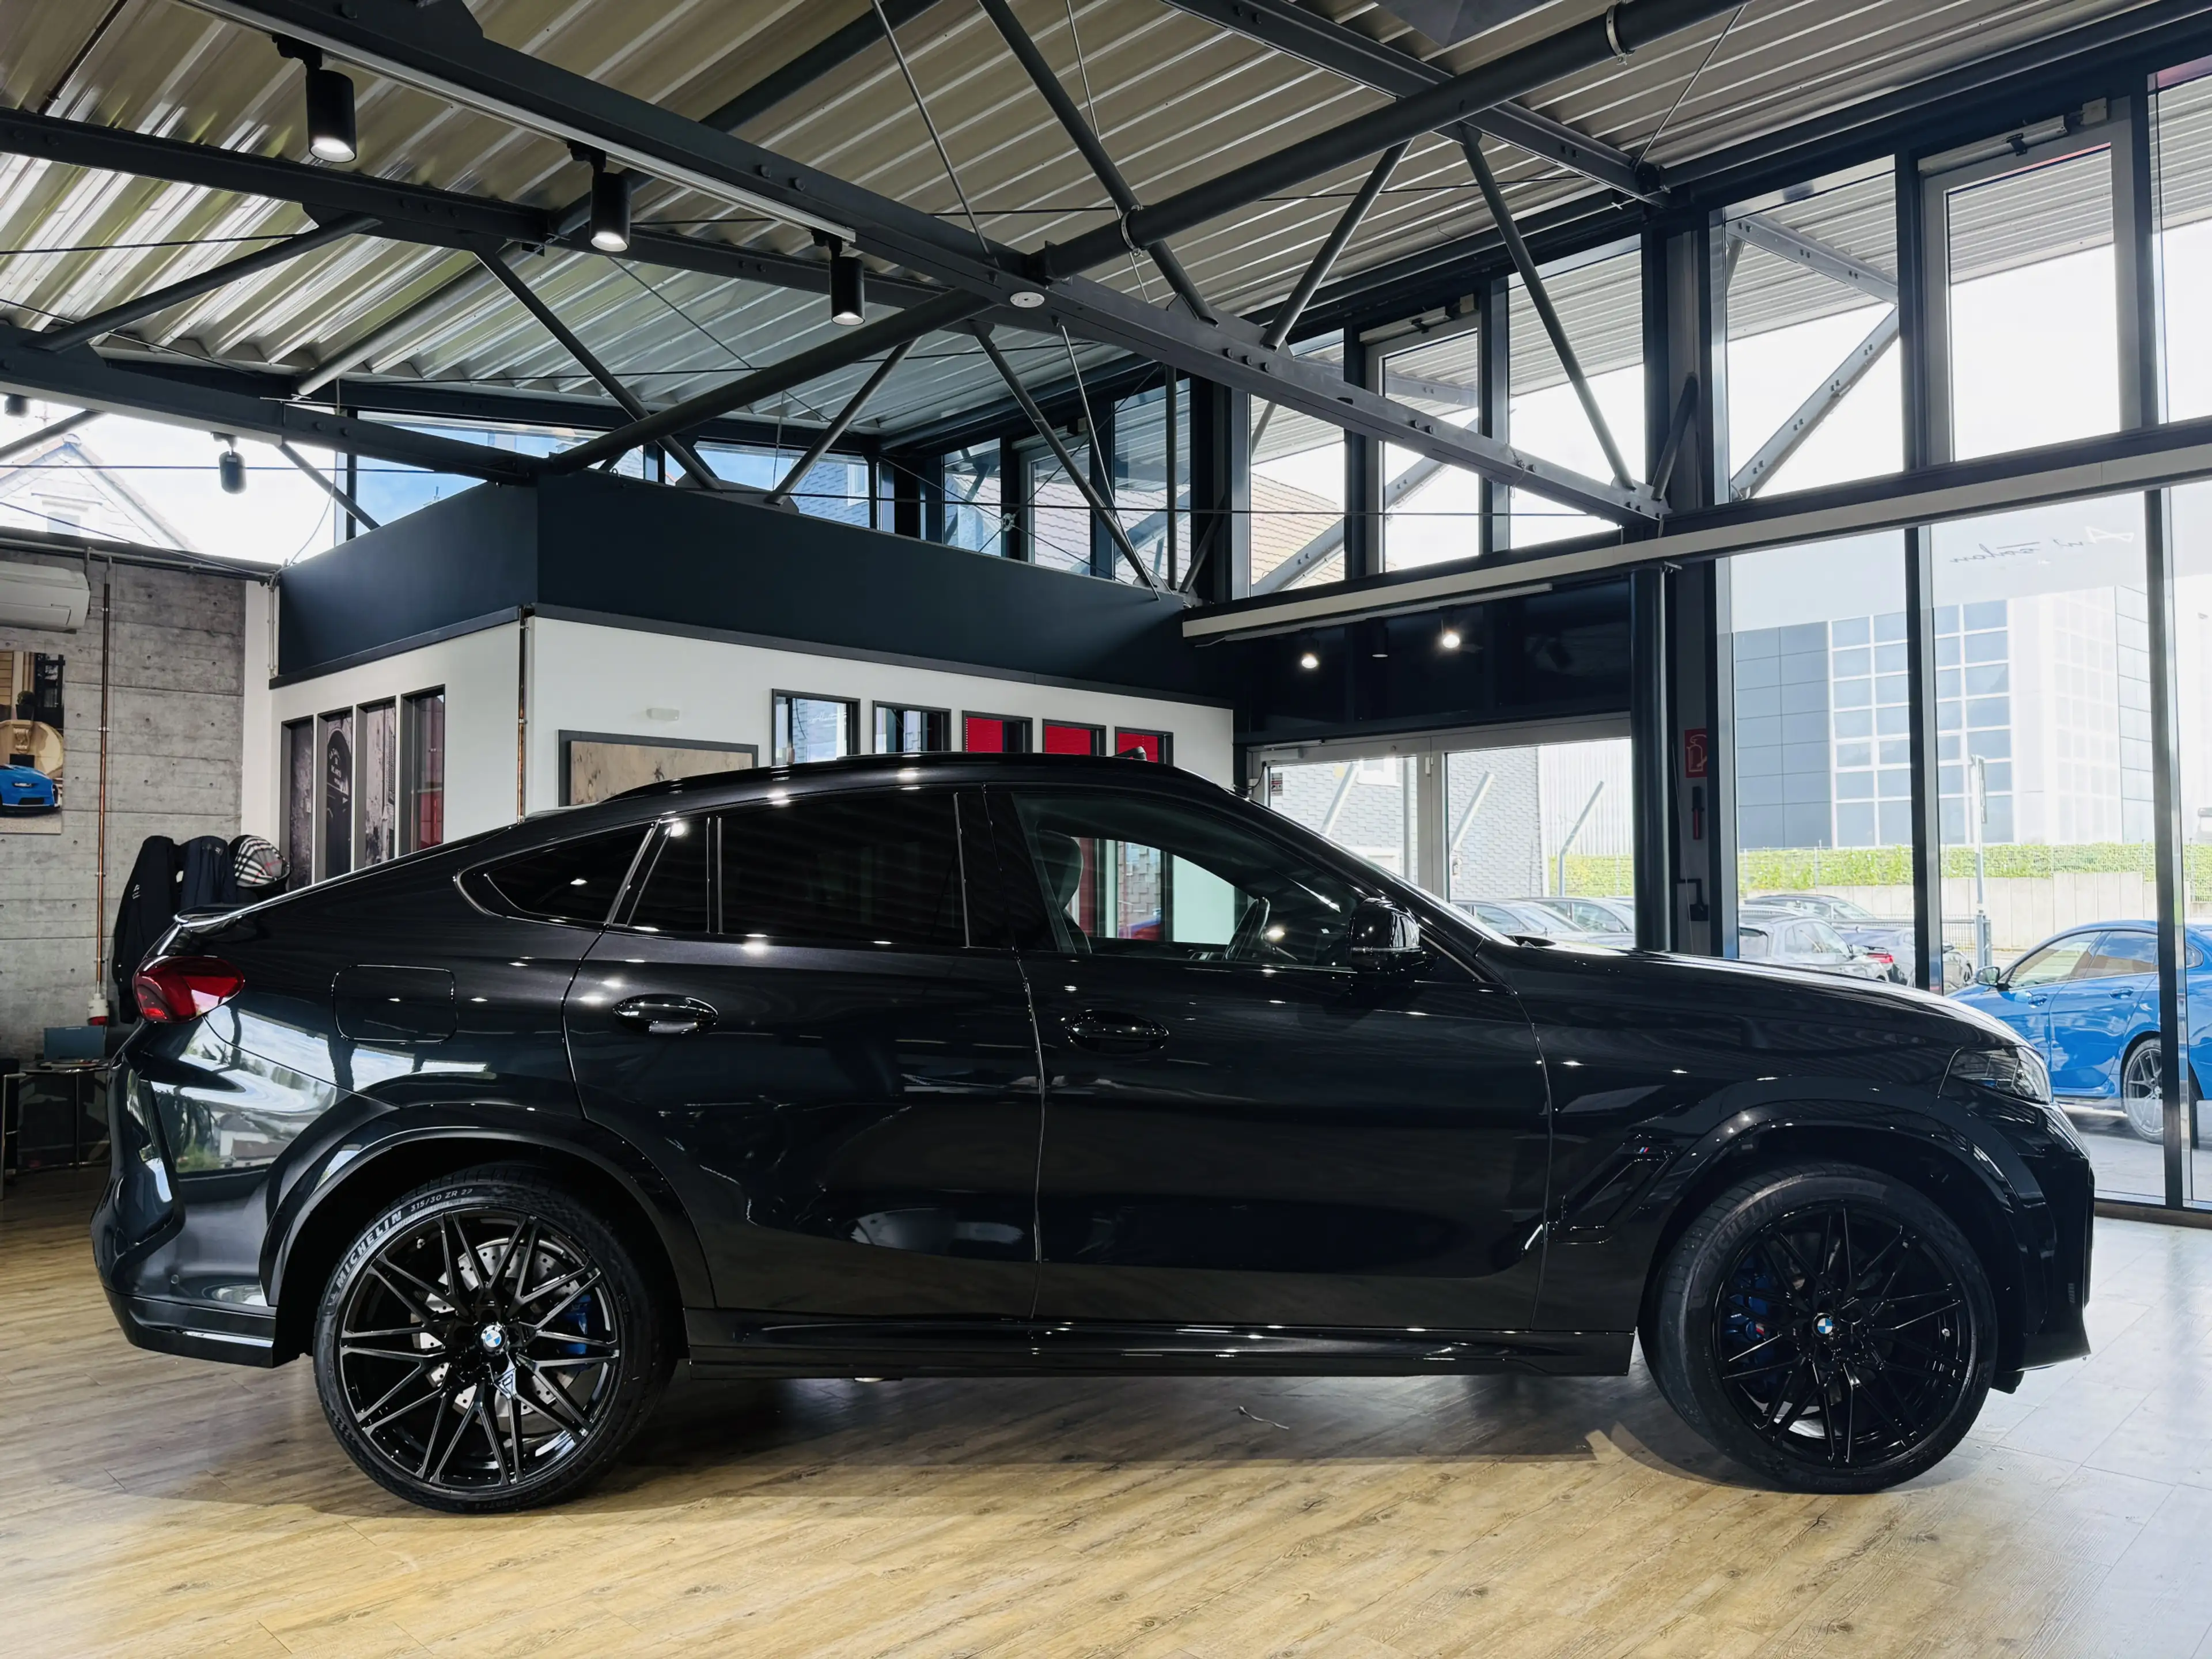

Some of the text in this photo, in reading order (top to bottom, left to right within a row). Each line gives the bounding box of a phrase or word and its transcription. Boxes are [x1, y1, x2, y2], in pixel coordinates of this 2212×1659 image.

[336, 1210, 402, 1289] MICHELIN
[410, 1194, 442, 1212] 315/30
[445, 1190, 458, 1199] ZR
